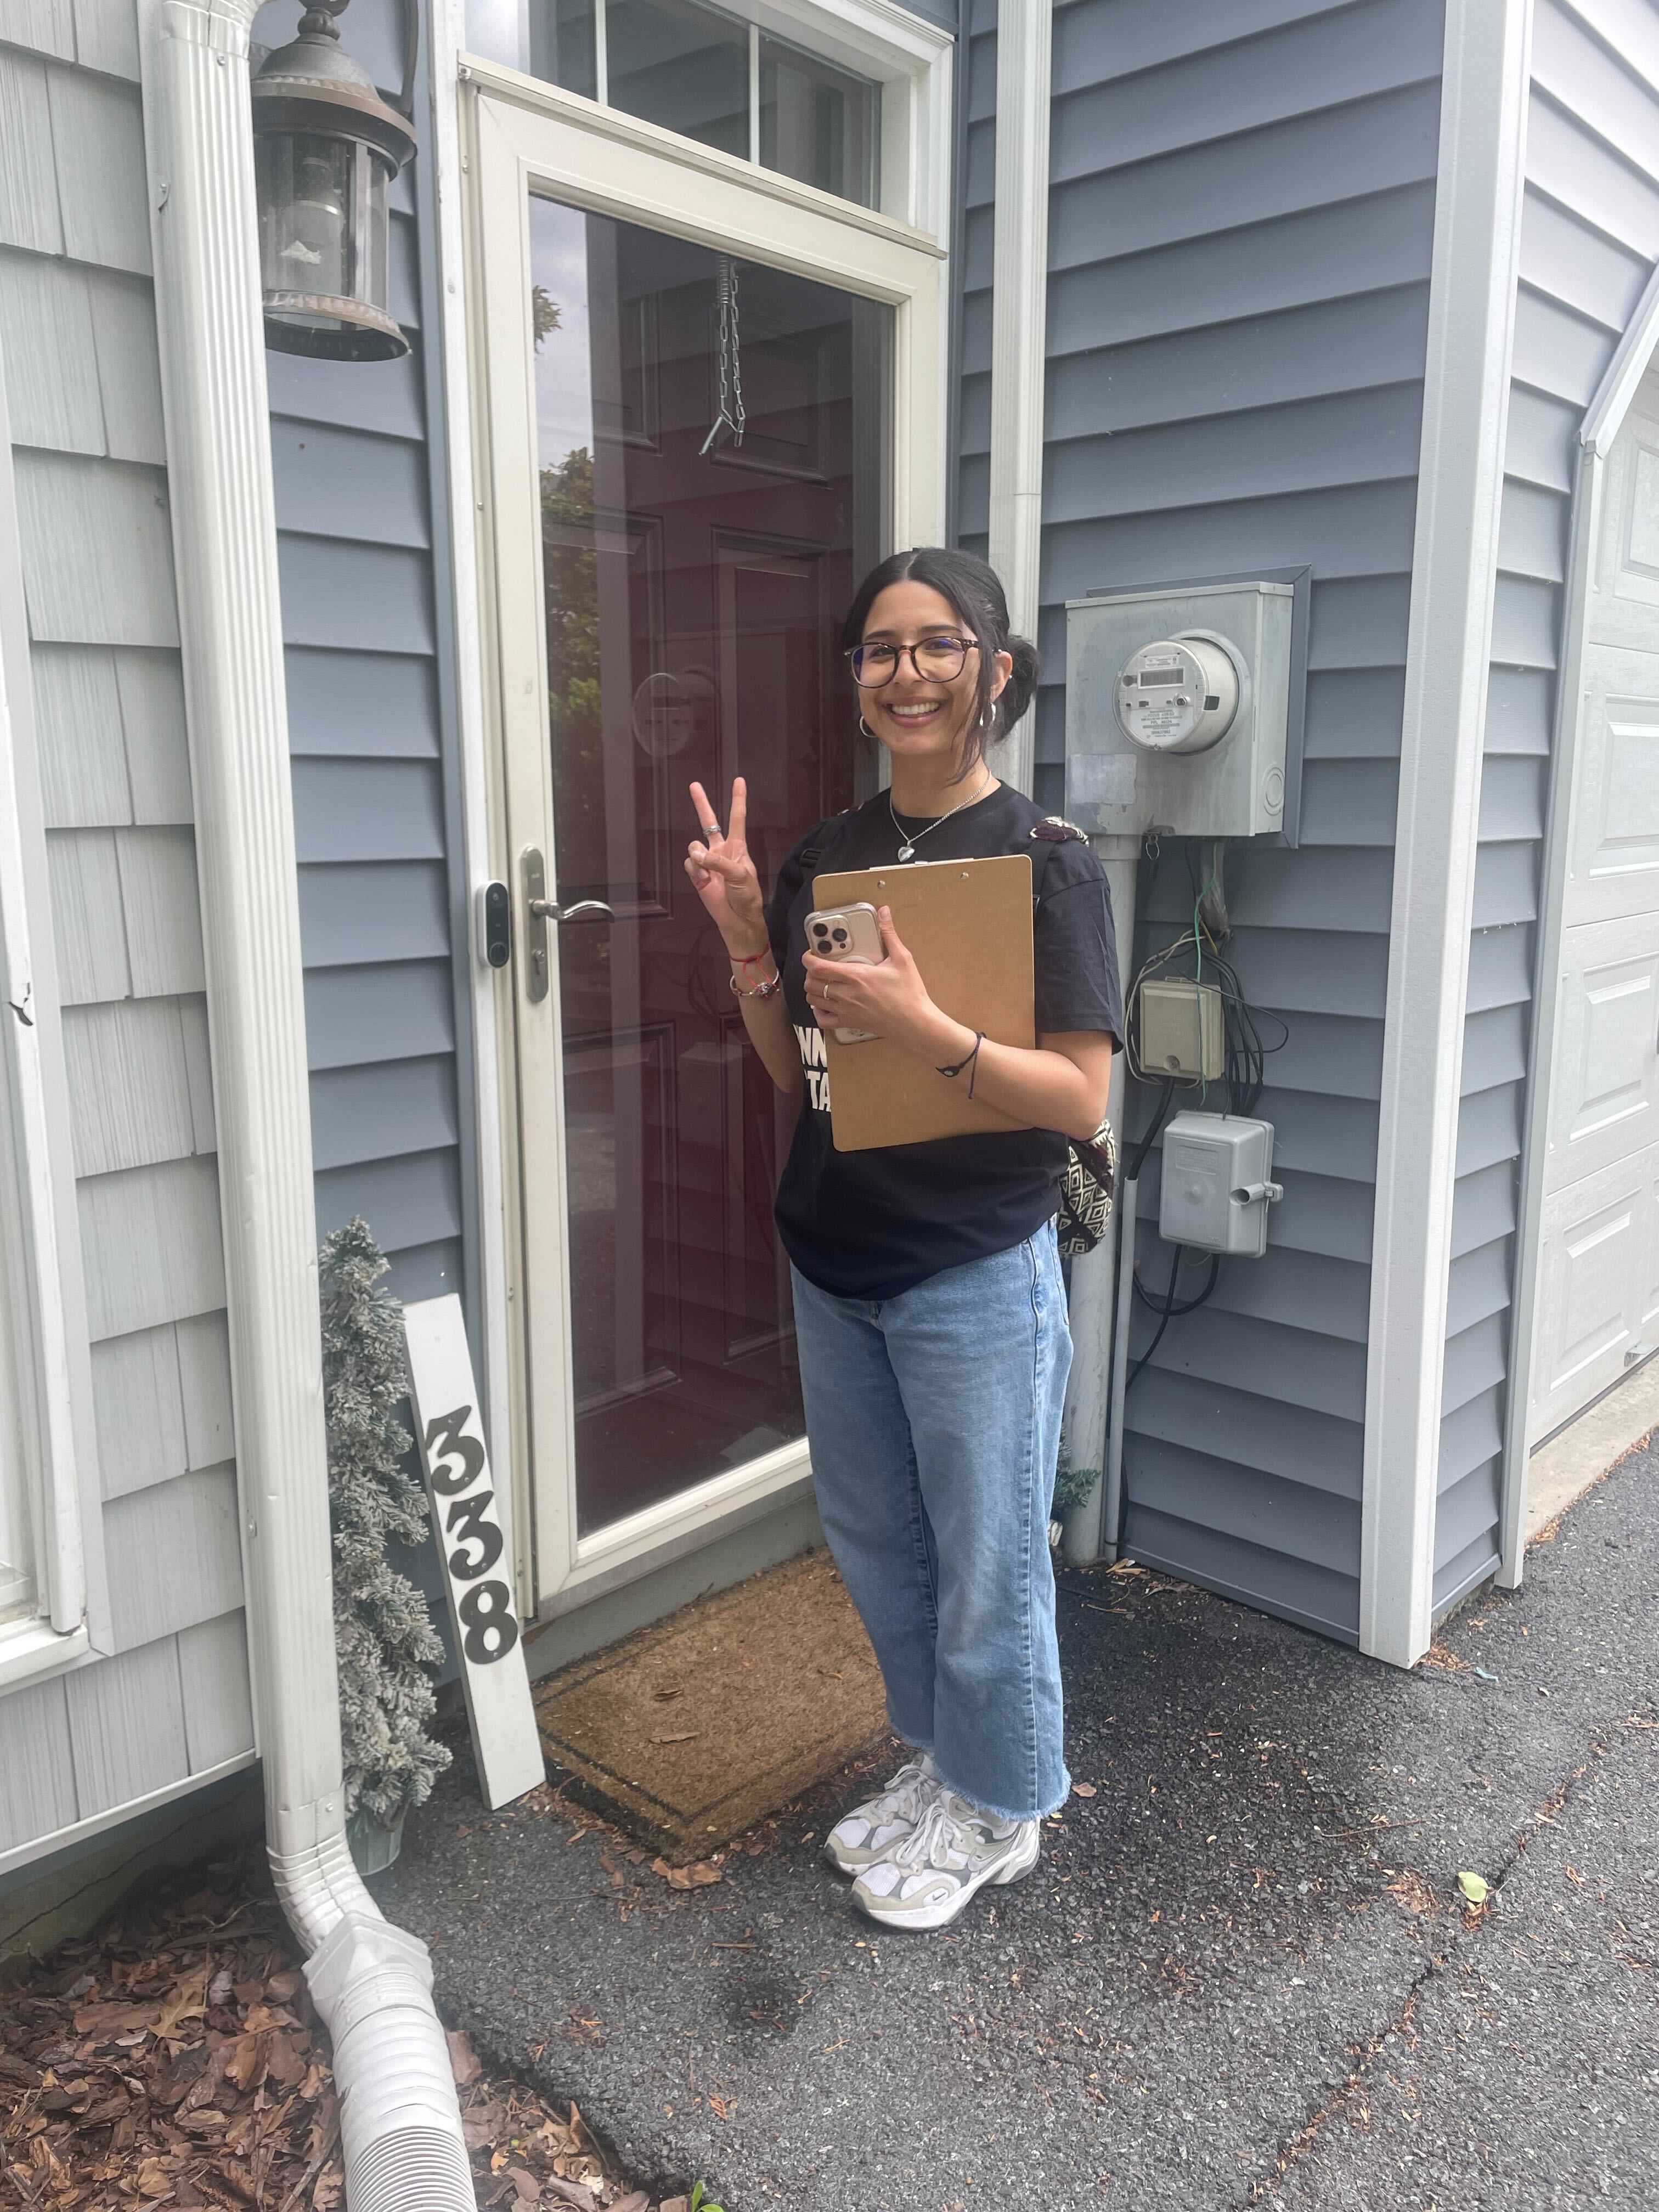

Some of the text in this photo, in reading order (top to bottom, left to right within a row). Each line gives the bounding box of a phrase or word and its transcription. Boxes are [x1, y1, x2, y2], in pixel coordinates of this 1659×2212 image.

[793, 1024, 827, 1068] NN
[804, 1069, 831, 1112] TA
[426, 1405, 518, 1664] 338
